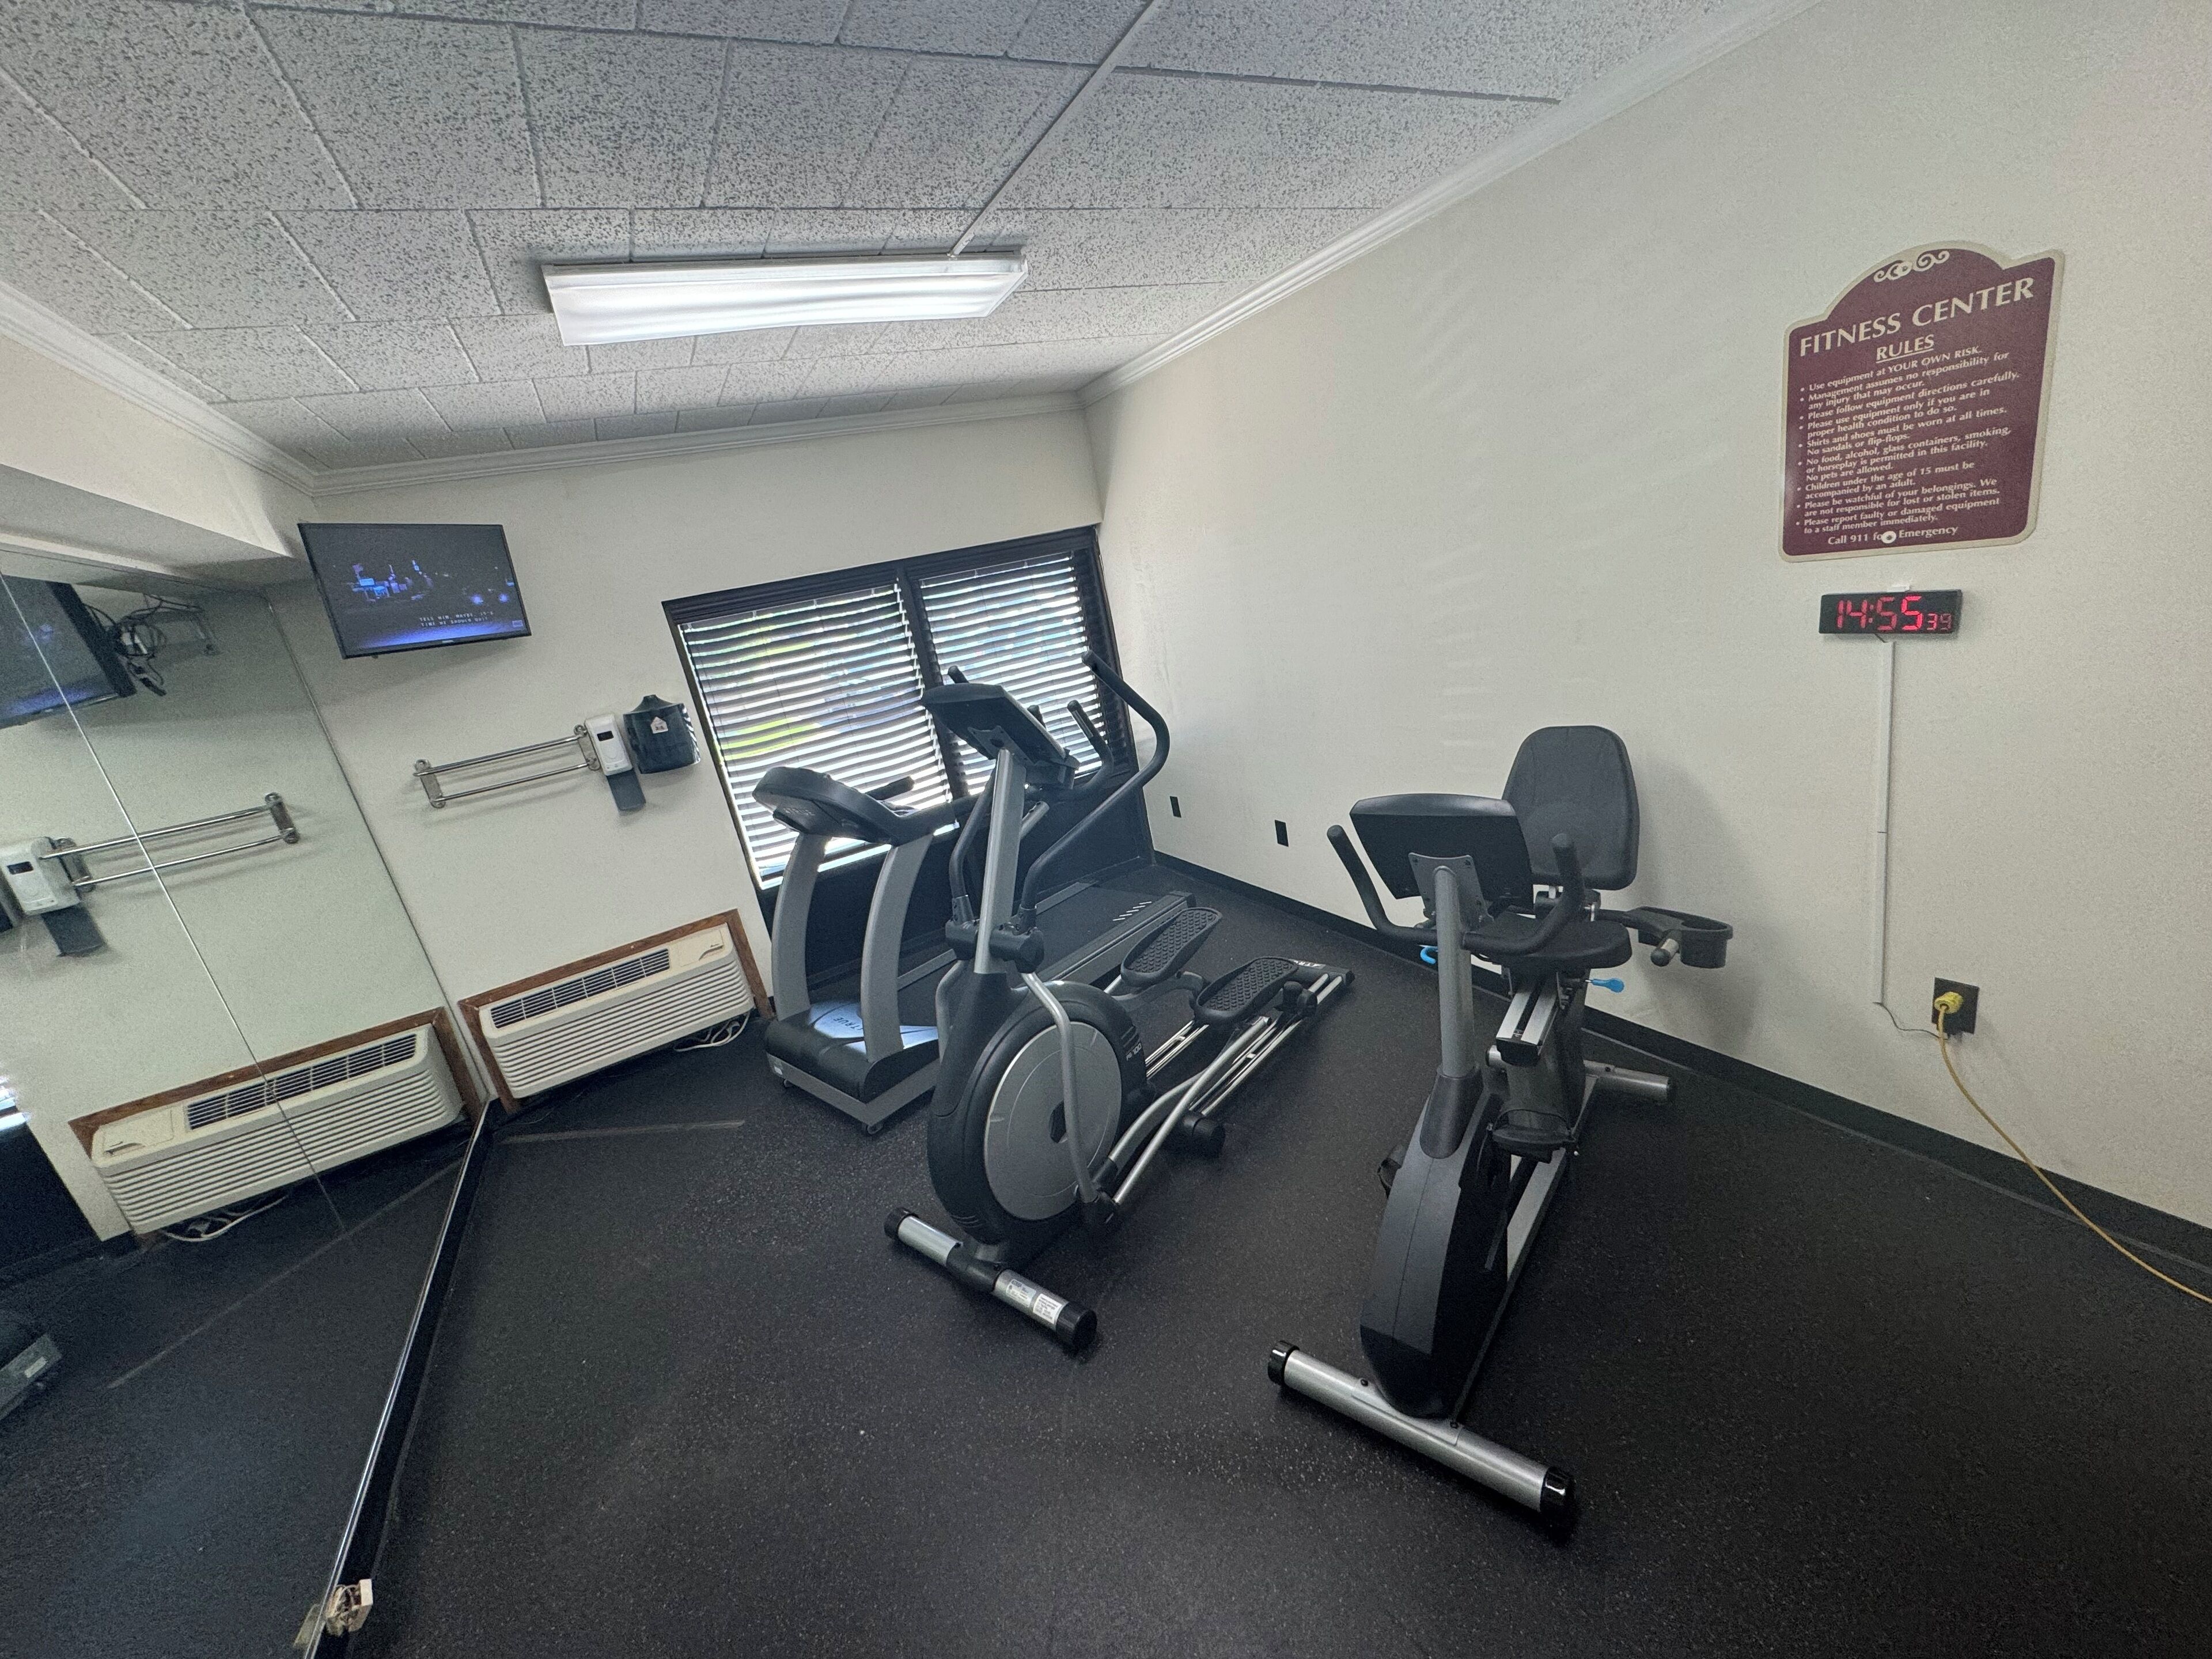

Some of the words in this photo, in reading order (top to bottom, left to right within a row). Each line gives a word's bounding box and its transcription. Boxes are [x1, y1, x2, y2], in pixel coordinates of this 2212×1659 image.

[1800, 312, 1901, 357] FITNESS
[1912, 278, 2034, 326] CENTER
[1876, 334, 1934, 361] RULES
[1808, 384, 1862, 402] Management
[1866, 376, 1903, 389] assumes
[1906, 372, 1918, 380] no
[1922, 357, 1989, 377] responsibility
[1994, 352, 2009, 361] for
[1827, 370, 1873, 388] equipment
[1888, 360, 1918, 373] YOUR
[1921, 353, 1950, 366] OWN
[1808, 402, 1823, 410] any
[1826, 396, 1850, 407] injury
[1854, 391, 1870, 400] that
[1874, 387, 1892, 396] may
[1895, 380, 1925, 391] occur.
[1808, 410, 1834, 420] Please
[1836, 404, 1863, 414] follow
[1866, 392, 1914, 408] equipment
[1918, 382, 1968, 397] directions
[1971, 370, 2019, 387] carefully.
[1808, 419, 1832, 430] Please
[1836, 416, 1850, 424] use
[1853, 406, 1900, 421] equipment
[1903, 401, 1924, 410] only
[1927, 398, 1935, 407] if
[1938, 396, 1956, 406] you
[1959, 392, 1976, 400] are
[1808, 428, 1835, 440] proper
[1838, 422, 1864, 431] health
[1868, 414, 1910, 427] condition
[1927, 407, 1940, 415] do
[1807, 438, 1830, 448] Shirts
[1832, 434, 1848, 443] and
[1851, 430, 1874, 440] shoes
[1877, 425, 1900, 434] must
[1903, 423, 1914, 431] be
[1918, 418, 1942, 427] worn
[1946, 415, 1956, 423] at
[1959, 411, 1972, 421] all
[1976, 407, 2007, 418] times.
[1818, 461, 1857, 472] horseplay
[1870, 450, 1914, 465] permitted
[1930, 445, 1948, 454] this
[1952, 440, 1987, 451] facility.
[1822, 442, 1852, 453] sandals
[1846, 448, 1880, 459] alcohol,
[1883, 443, 1904, 454] glass
[1908, 435, 1961, 449] containers,
[1965, 427, 2012, 440] smoking,
[1805, 481, 1840, 491] Children
[1843, 477, 1868, 486] under
[1871, 474, 1885, 482] the
[1888, 471, 1903, 481] age
[1907, 468, 1916, 477] of
[1921, 467, 1931, 475] 15
[1935, 463, 1959, 473] must
[1821, 472, 1838, 481] pets
[1857, 463, 1893, 474] allowed.
[1805, 487, 1859, 499] accompanied
[1862, 484, 1872, 493] by
[1889, 479, 1916, 488] adult.
[1805, 501, 1830, 509] Please
[1846, 493, 1882, 503] watchful
[1897, 488, 1918, 498] your
[1922, 482, 1976, 494] belongings.
[1980, 478, 1997, 486] We
[1820, 507, 1834, 515] not
[1836, 502, 1884, 513] responsible
[1887, 499, 1900, 507] for
[1937, 491, 1966, 501] stolen
[1970, 488, 2000, 497] items.
[1804, 517, 1829, 526] Please
[1831, 514, 1857, 525] report
[1861, 512, 1884, 520] faulty
[1900, 503, 1943, 515] damaged
[1945, 498, 1999, 512] equipment
[1822, 524, 1840, 532] staff
[1842, 521, 1877, 530] member
[1881, 514, 1938, 526] immediately.
[1828, 536, 1847, 545] Call
[1850, 534, 1868, 542] 911
[1873, 532, 1883, 540] fo
[1899, 527, 1958, 538] Emergency
[1837, 595, 1923, 631] 14:55
[833, 1017, 860, 1029] TRUE
